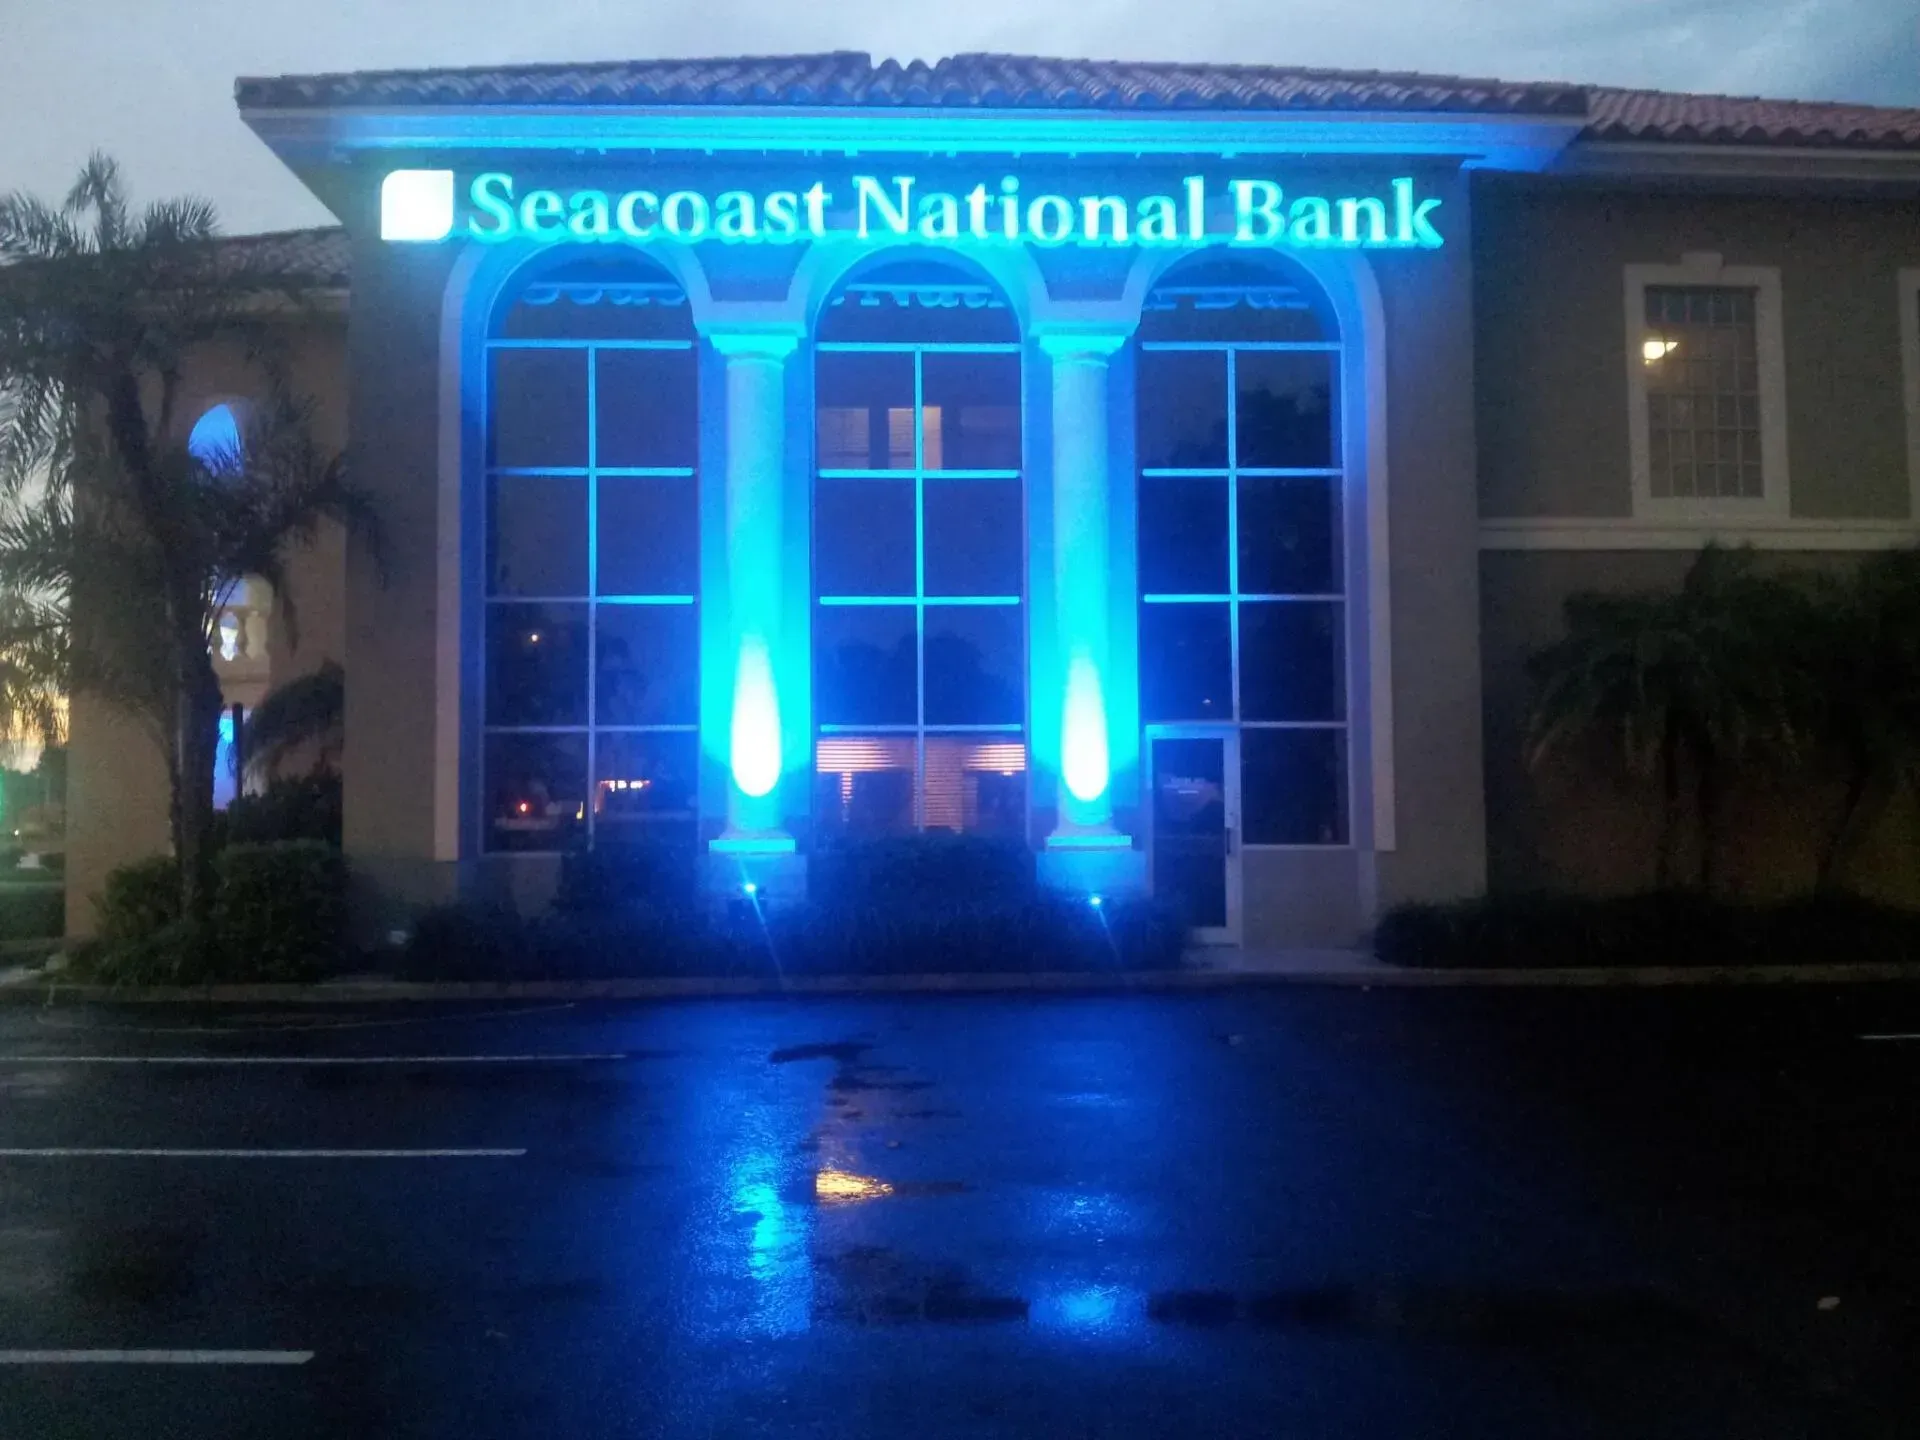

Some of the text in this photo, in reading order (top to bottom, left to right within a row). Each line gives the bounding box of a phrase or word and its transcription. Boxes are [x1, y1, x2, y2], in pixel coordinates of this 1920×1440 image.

[468, 172, 1445, 249] Seacoast National Bank
